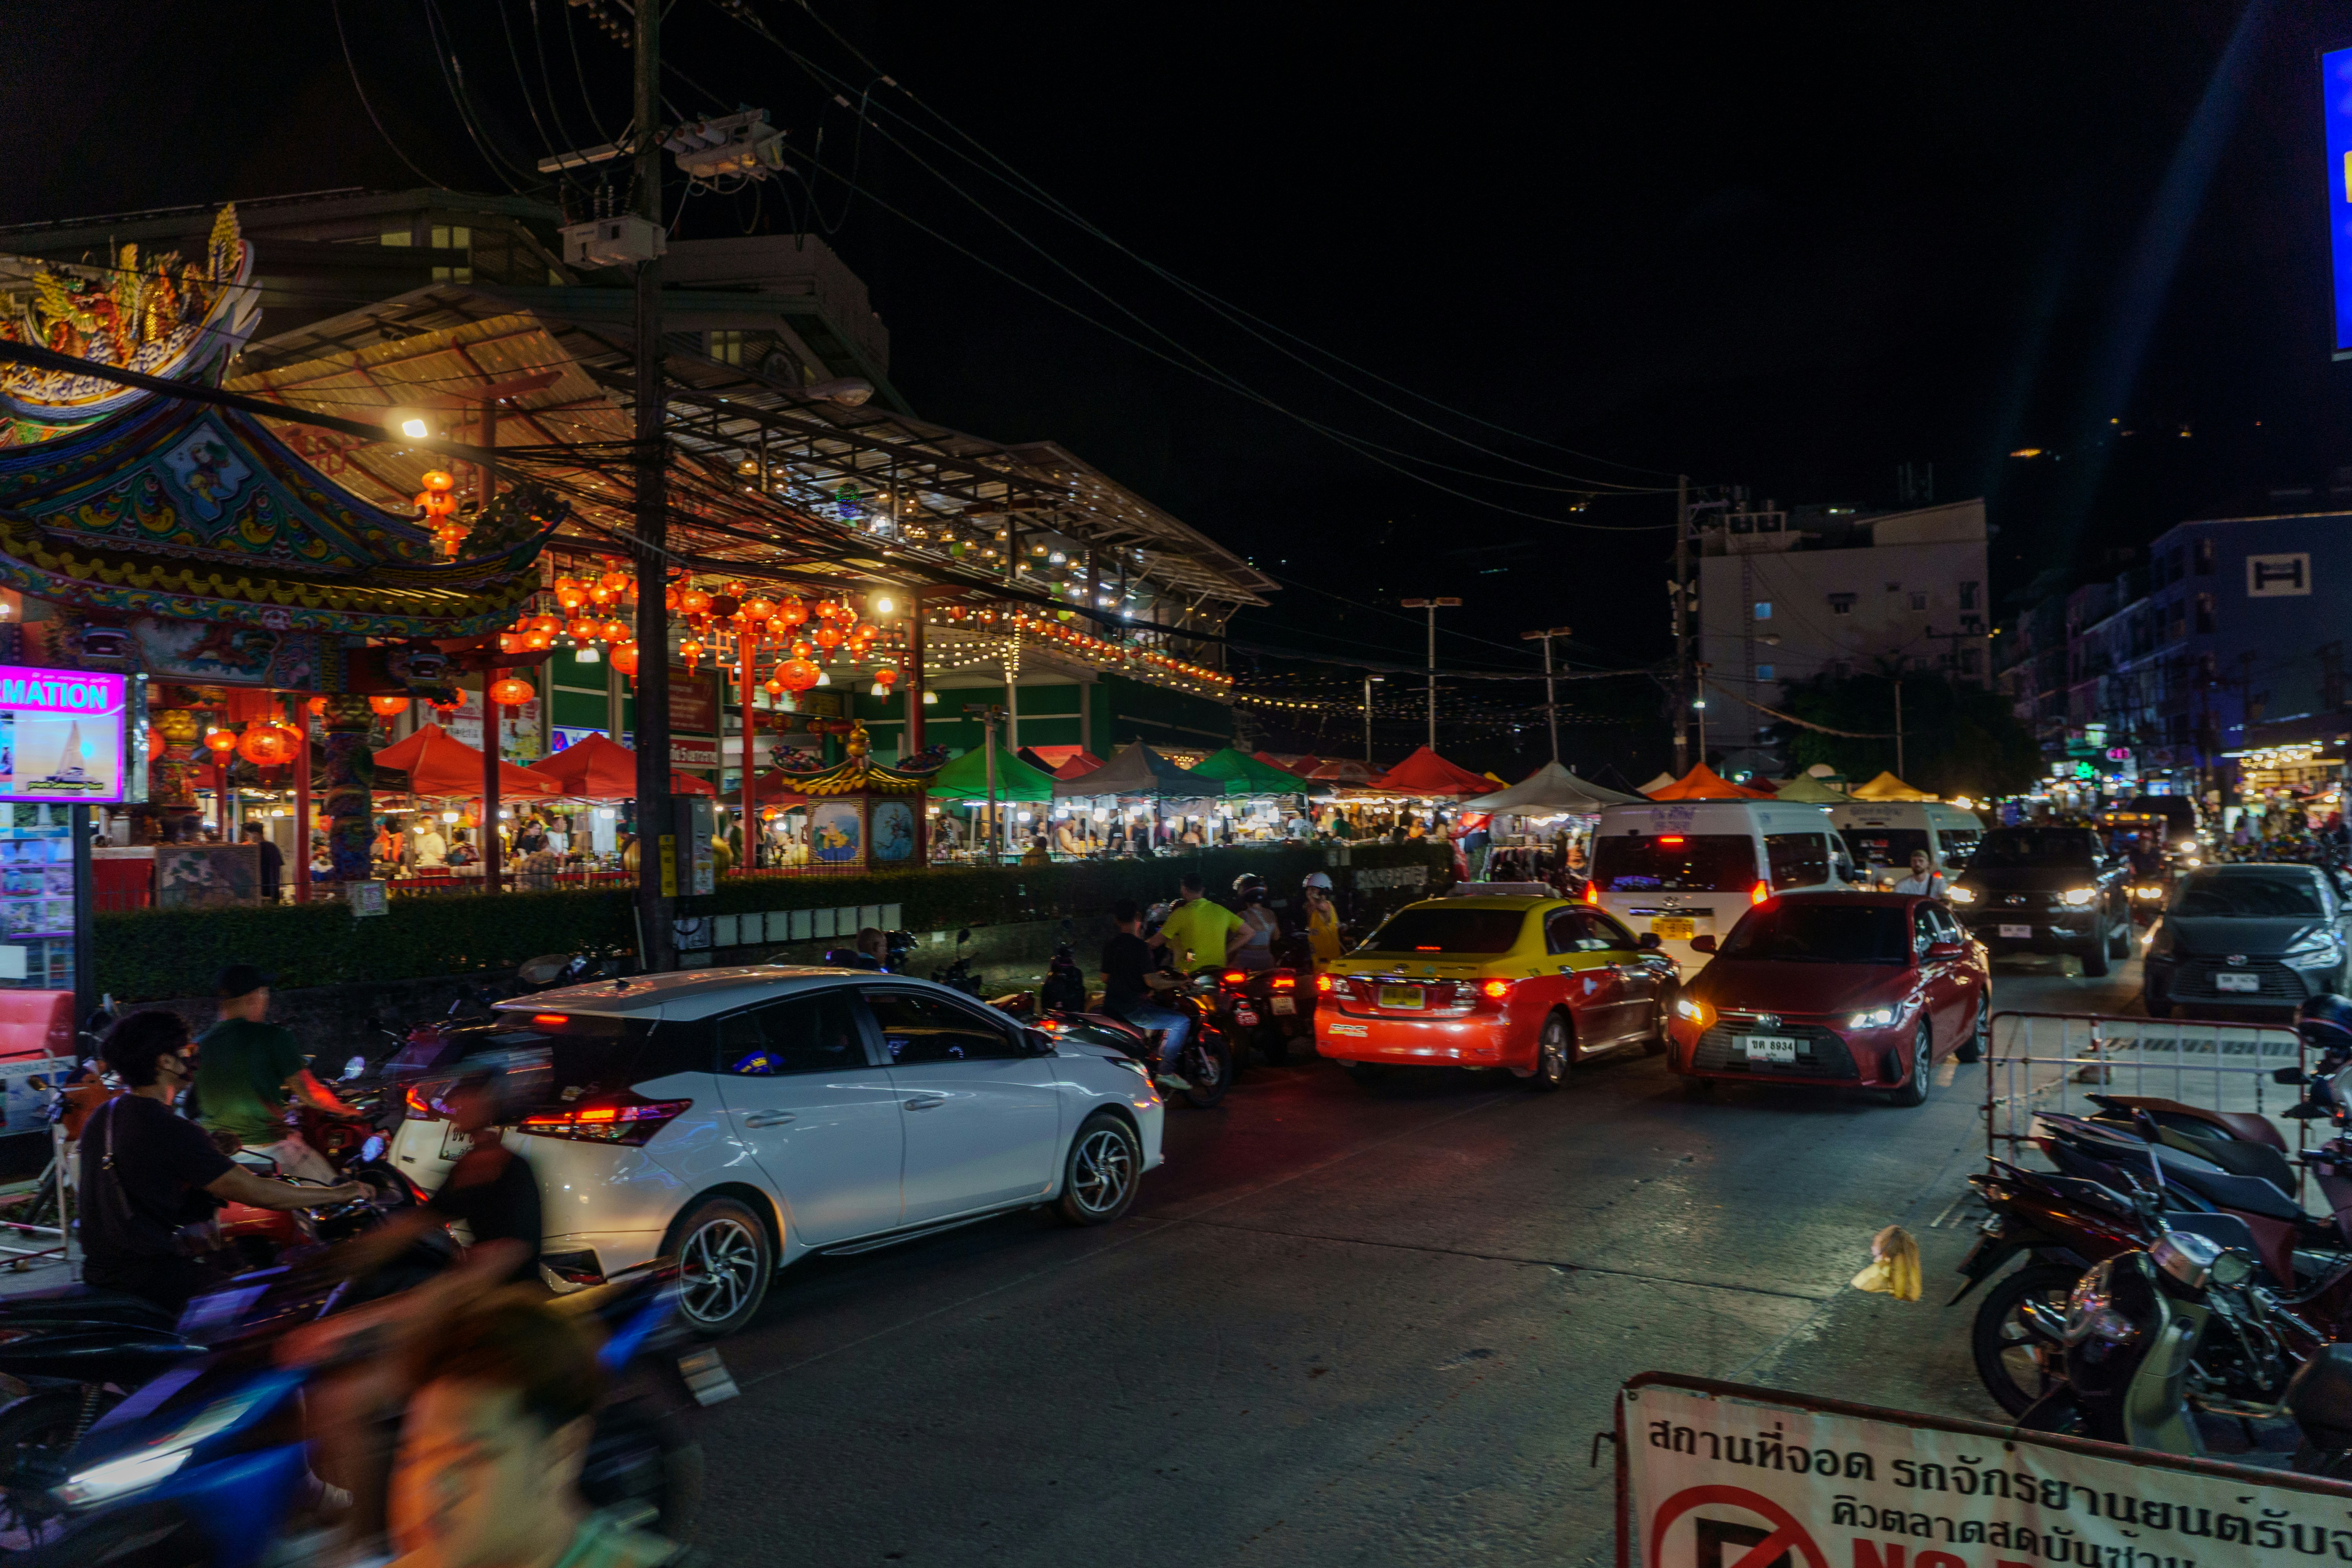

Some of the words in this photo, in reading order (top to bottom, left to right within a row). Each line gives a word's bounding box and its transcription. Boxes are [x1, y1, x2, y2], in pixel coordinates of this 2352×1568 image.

[0, 679, 108, 710] MATION
[1770, 1041, 1792, 1051] 8934
[1649, 1421, 1876, 1481] สถานที่จอด
